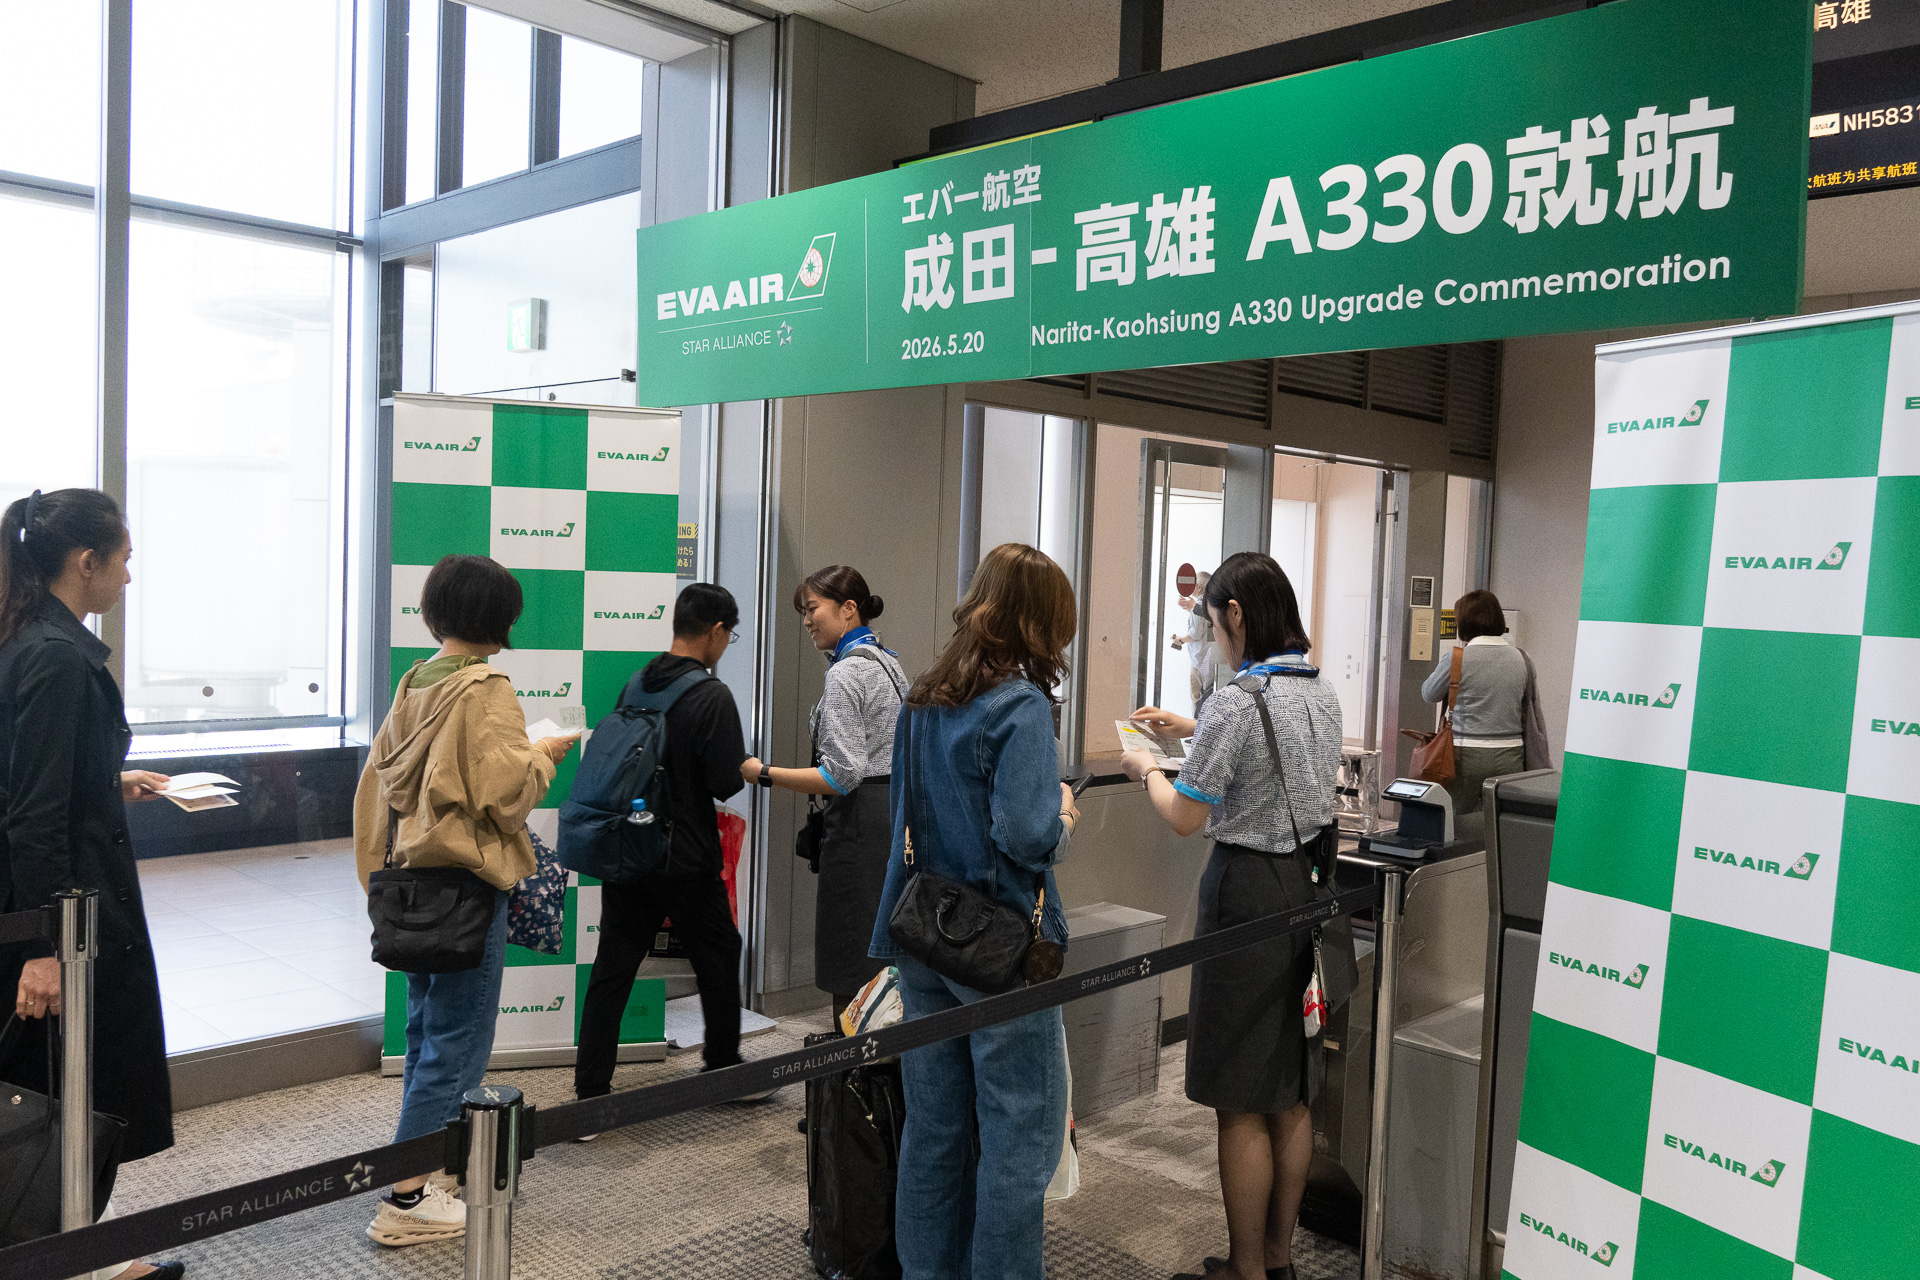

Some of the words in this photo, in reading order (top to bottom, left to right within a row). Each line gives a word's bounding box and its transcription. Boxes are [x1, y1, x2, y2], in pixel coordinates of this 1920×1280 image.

[901, 163, 1042, 225] エバー航空
[1030, 309, 1221, 347] Narita-Kaohsiung
[1228, 296, 1293, 327] A330
[1301, 283, 1424, 324] Upgrade
[1434, 253, 1730, 306] Commemoration
[680, 338, 711, 356] STAR
[712, 329, 772, 352] ALLIANCE
[901, 330, 985, 361] 2026.5.20
[401, 606, 424, 615] EV
[1290, 915, 1303, 925] STAR
[1081, 977, 1100, 989] STAR
[1102, 965, 1136, 983] ALLIANCE
[498, 1006, 518, 1014] VA
[772, 1062, 801, 1078] STAR
[803, 1047, 856, 1070] ALLIANCE
[182, 1206, 233, 1231] STAR
[240, 1176, 334, 1215] ALLIANCE
